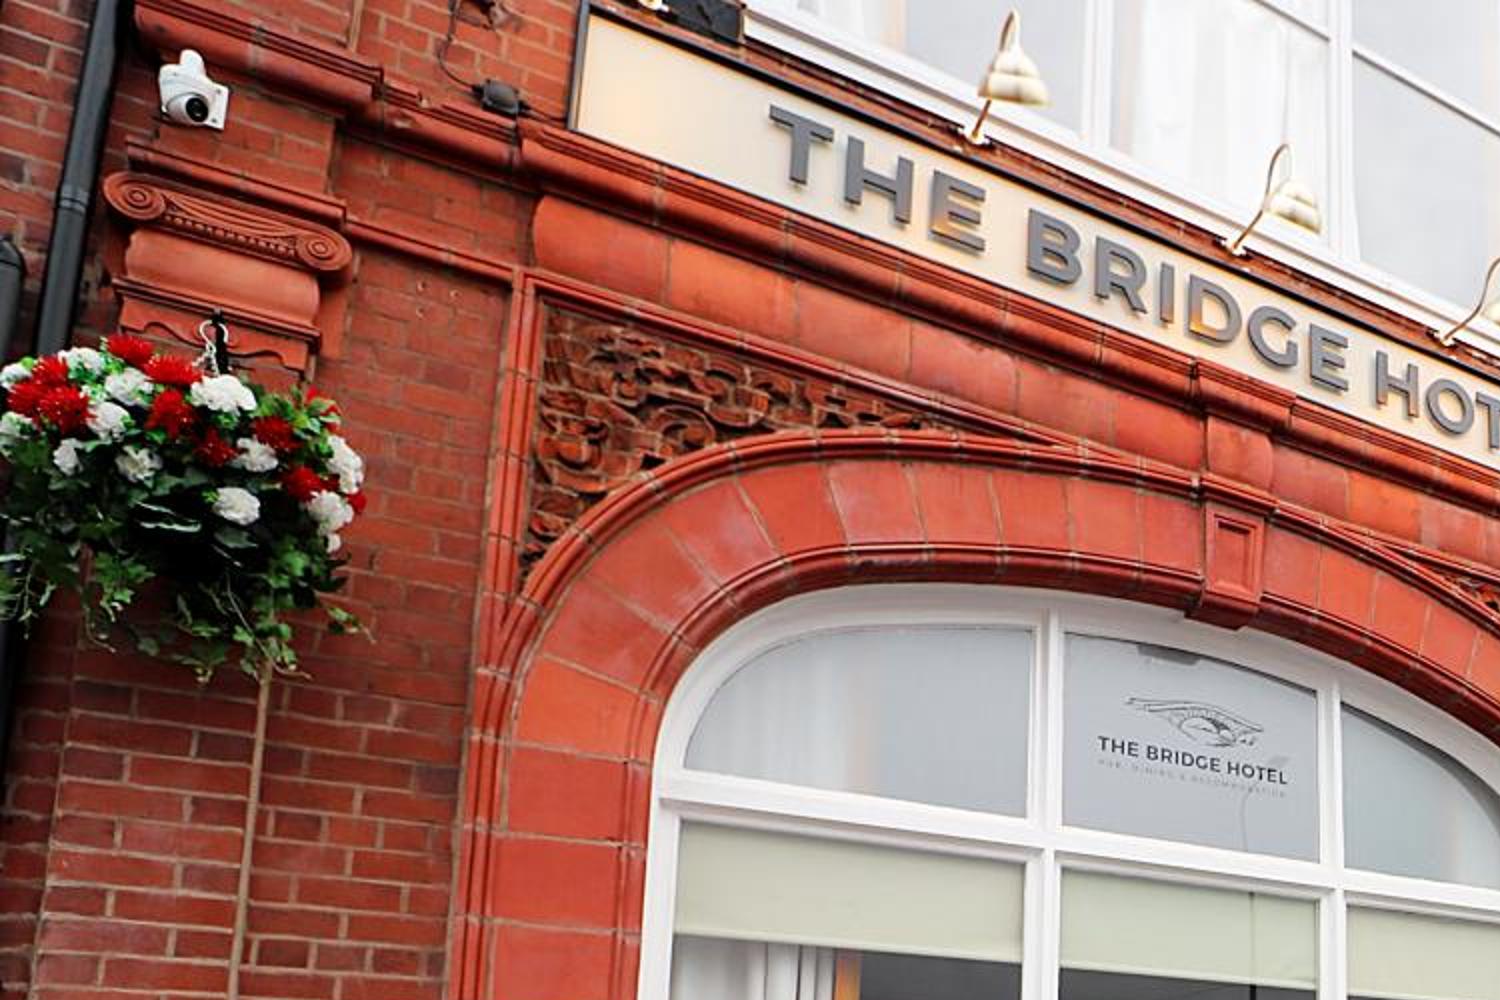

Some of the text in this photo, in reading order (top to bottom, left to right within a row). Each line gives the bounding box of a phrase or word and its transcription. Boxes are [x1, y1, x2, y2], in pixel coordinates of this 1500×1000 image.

[768, 104, 987, 252] THE
[1026, 207, 1348, 394] BRIDGE
[1098, 735, 1139, 758] THE
[1146, 745, 1221, 773] BRIDGE
[1227, 760, 1288, 785] HOTEL
